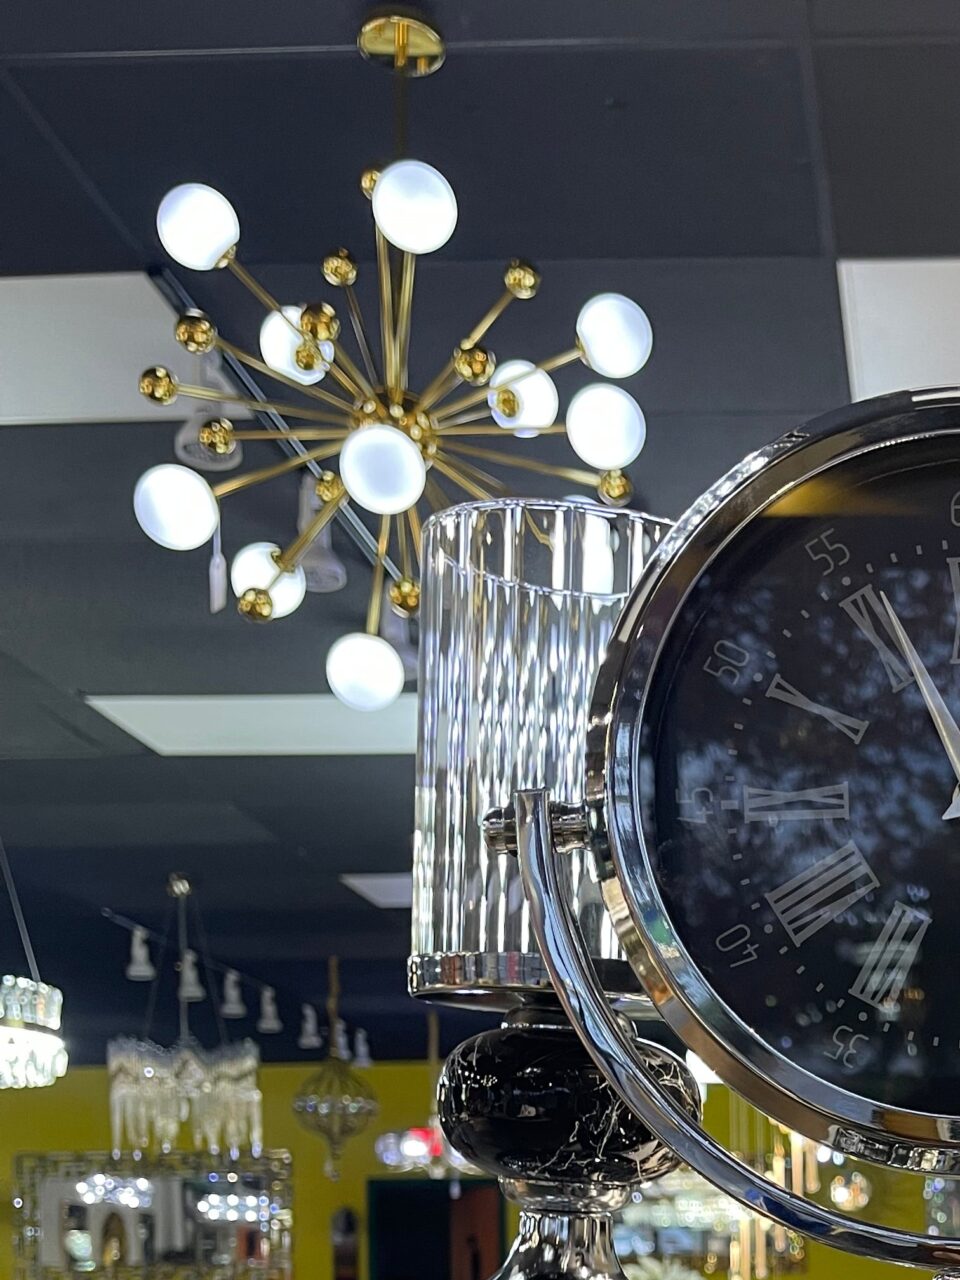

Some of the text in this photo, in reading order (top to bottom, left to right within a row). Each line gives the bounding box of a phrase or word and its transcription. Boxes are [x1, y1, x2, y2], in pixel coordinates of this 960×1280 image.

[805, 528, 850, 575] 55
[703, 640, 749, 685] 50
[675, 787, 714, 824] 45
[715, 924, 760, 968] 40
[823, 1025, 870, 1069] 35
